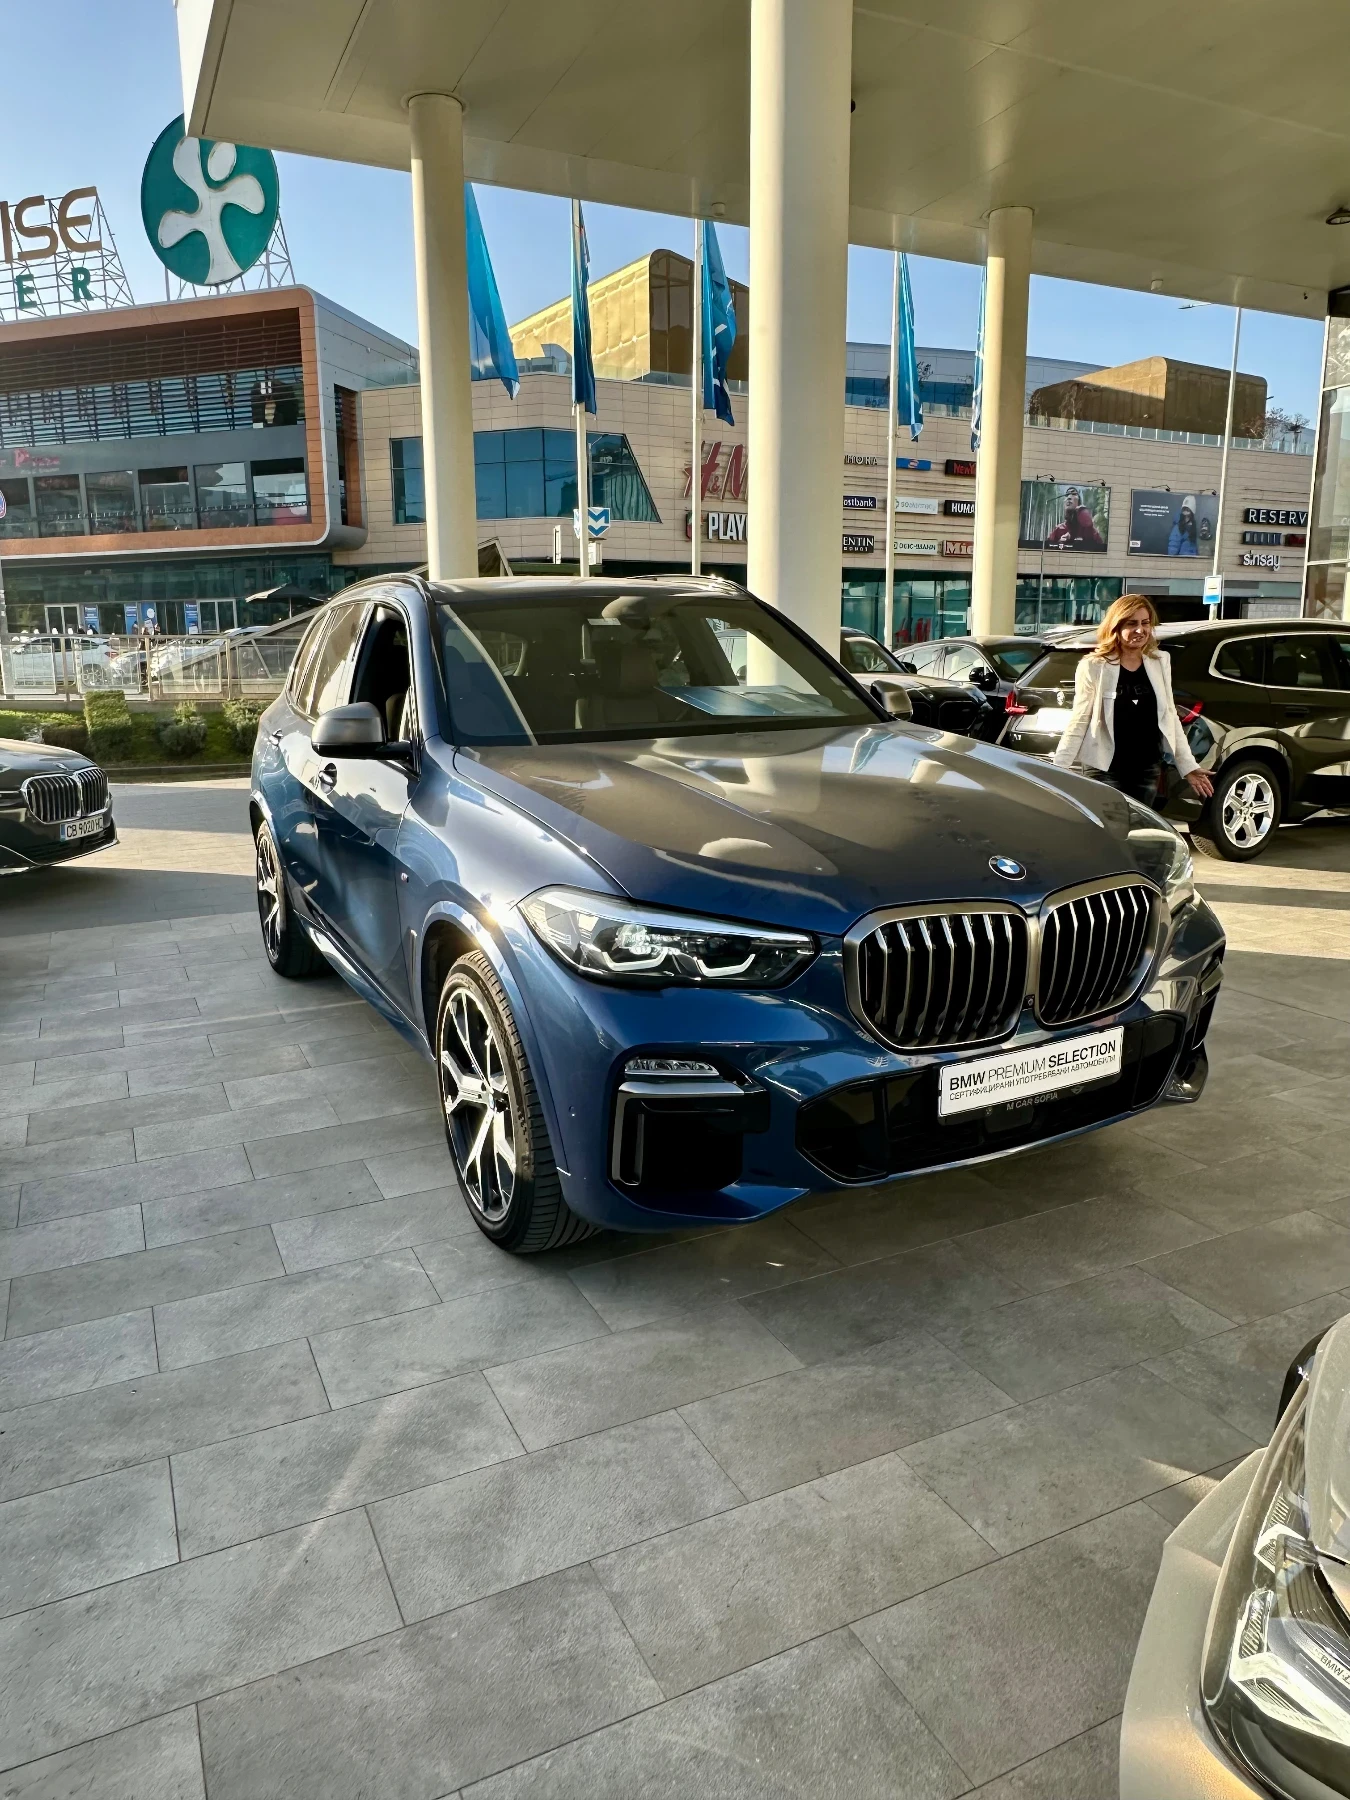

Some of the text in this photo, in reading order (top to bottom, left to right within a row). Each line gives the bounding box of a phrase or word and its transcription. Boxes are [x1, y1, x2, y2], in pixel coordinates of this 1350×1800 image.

[708, 512, 748, 541] PLAY
[1248, 508, 1308, 525] RESERV
[1243, 550, 1280, 572] sinsay
[950, 1040, 1117, 1091] BMW PREMIUM SELECTION
[1015, 1098, 1034, 1109] CAR
[1033, 1092, 1060, 1105] SOFIA
